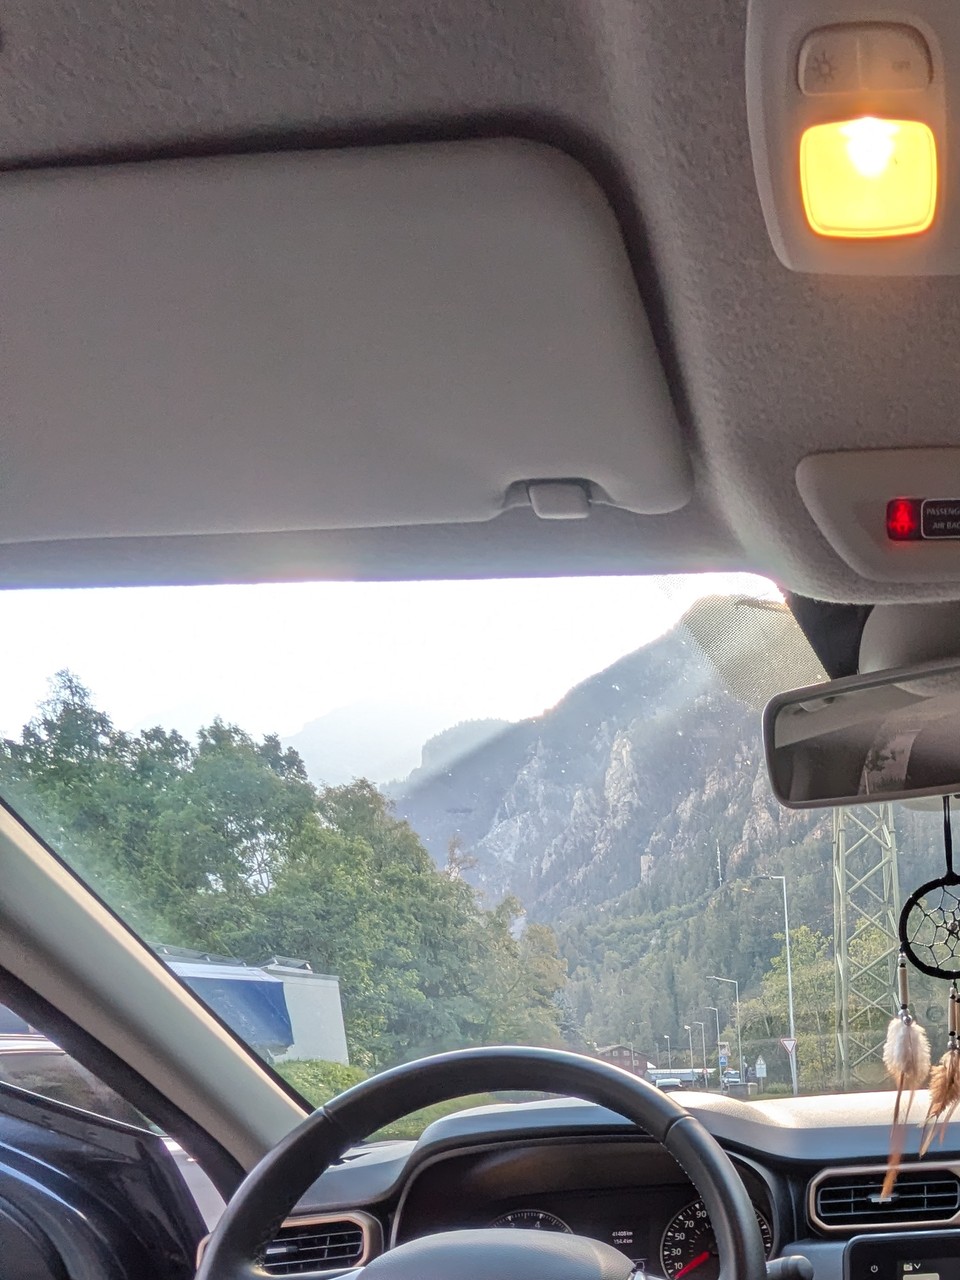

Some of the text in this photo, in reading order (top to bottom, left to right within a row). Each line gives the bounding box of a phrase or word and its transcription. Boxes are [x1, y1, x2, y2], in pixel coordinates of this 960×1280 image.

[695, 1210, 707, 1219] 90
[684, 1220, 695, 1228] 70
[674, 1233, 686, 1241] 50
[670, 1248, 682, 1256] 30
[674, 1262, 683, 1270] 10
